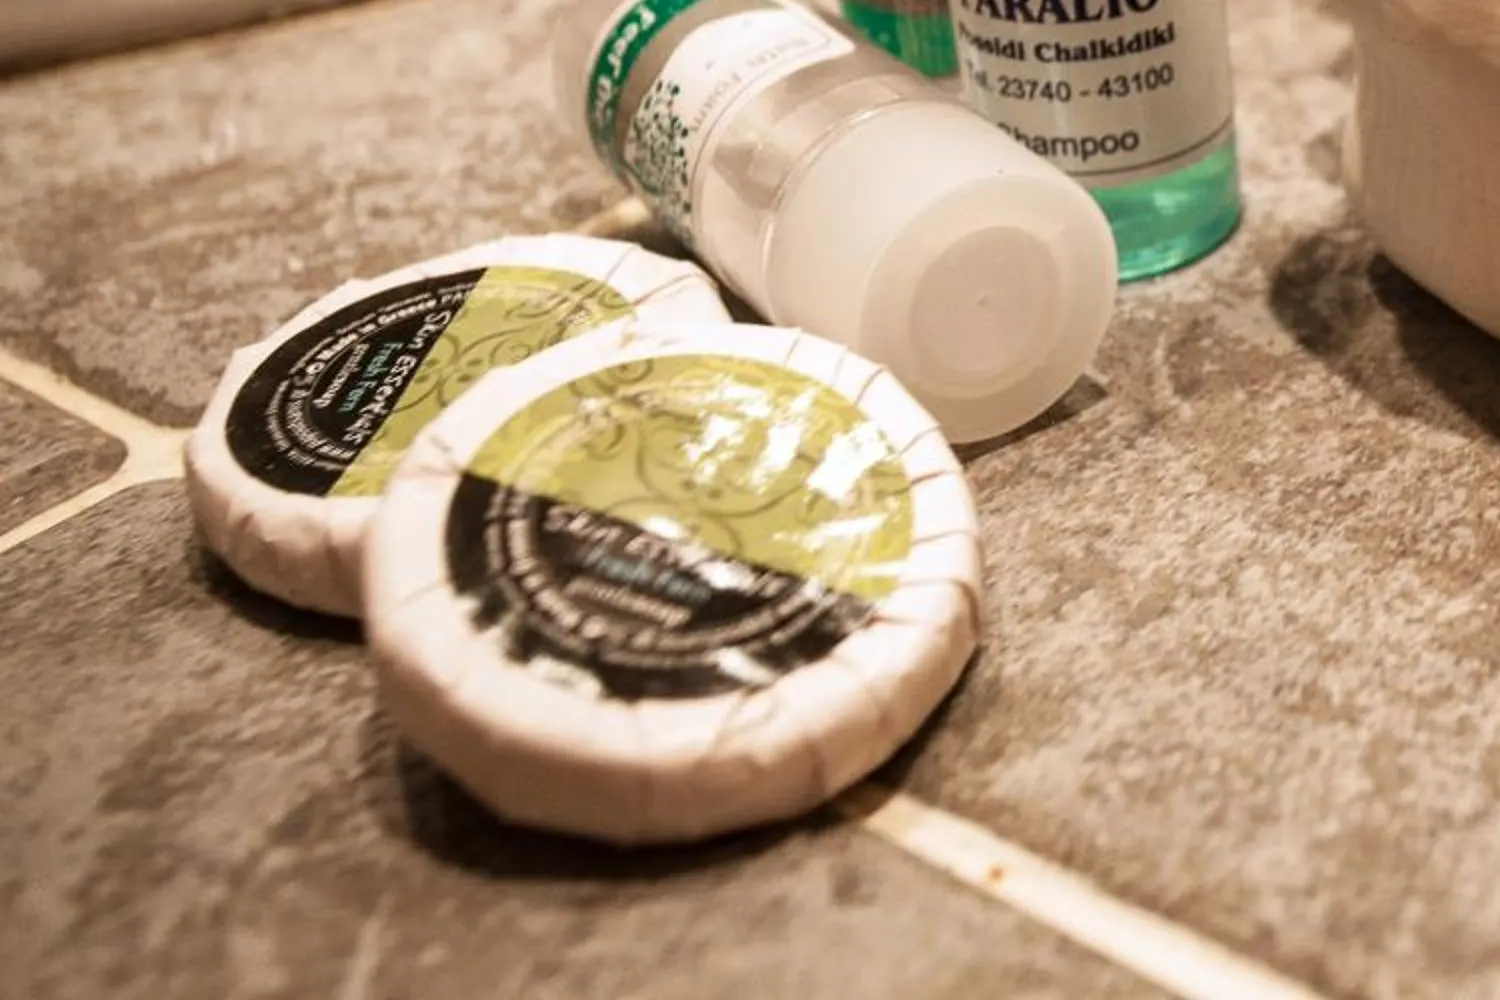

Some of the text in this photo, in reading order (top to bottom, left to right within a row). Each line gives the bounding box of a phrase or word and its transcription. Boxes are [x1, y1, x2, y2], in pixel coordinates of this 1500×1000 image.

[1033, 21, 1175, 63] Chalkidiki
[997, 73, 1072, 102] 23740
[1098, 62, 1175, 99] 43100
